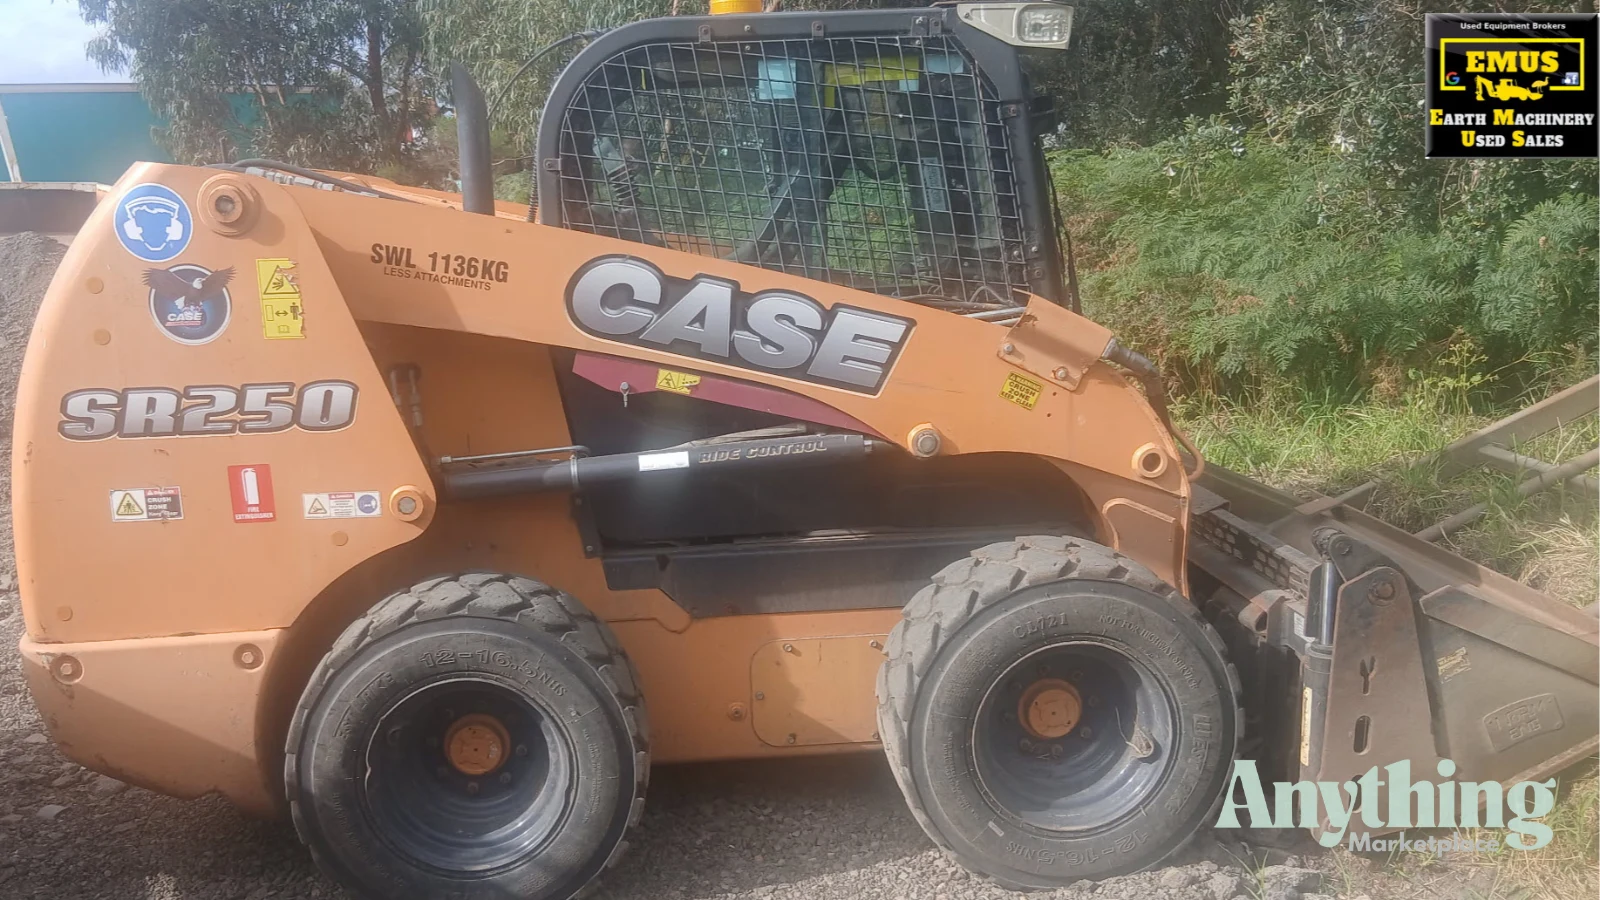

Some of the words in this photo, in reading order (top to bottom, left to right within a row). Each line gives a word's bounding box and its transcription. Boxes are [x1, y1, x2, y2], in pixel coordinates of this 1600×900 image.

[370, 243, 416, 269] SWL
[428, 251, 509, 283] 1136KG
[383, 266, 411, 279] LESS
[413, 271, 491, 291] ATTACHMENTS
[167, 312, 203, 322] CASE
[565, 255, 916, 397] CASE
[1001, 391, 1015, 400] KEEP
[1015, 398, 1033, 408] CLEAR
[1008, 381, 1036, 397] CRUSH
[1008, 387, 1031, 401] ZONE
[58, 379, 359, 441] SR250
[699, 449, 741, 464] RIDE
[745, 440, 828, 459] CONTROL
[1012, 612, 1069, 639] CL721
[1099, 614, 1122, 627] NOT
[1121, 619, 1140, 634] FOR
[1139, 627, 1174, 658] HIGHWAY
[1172, 653, 1201, 691] SERVICE
